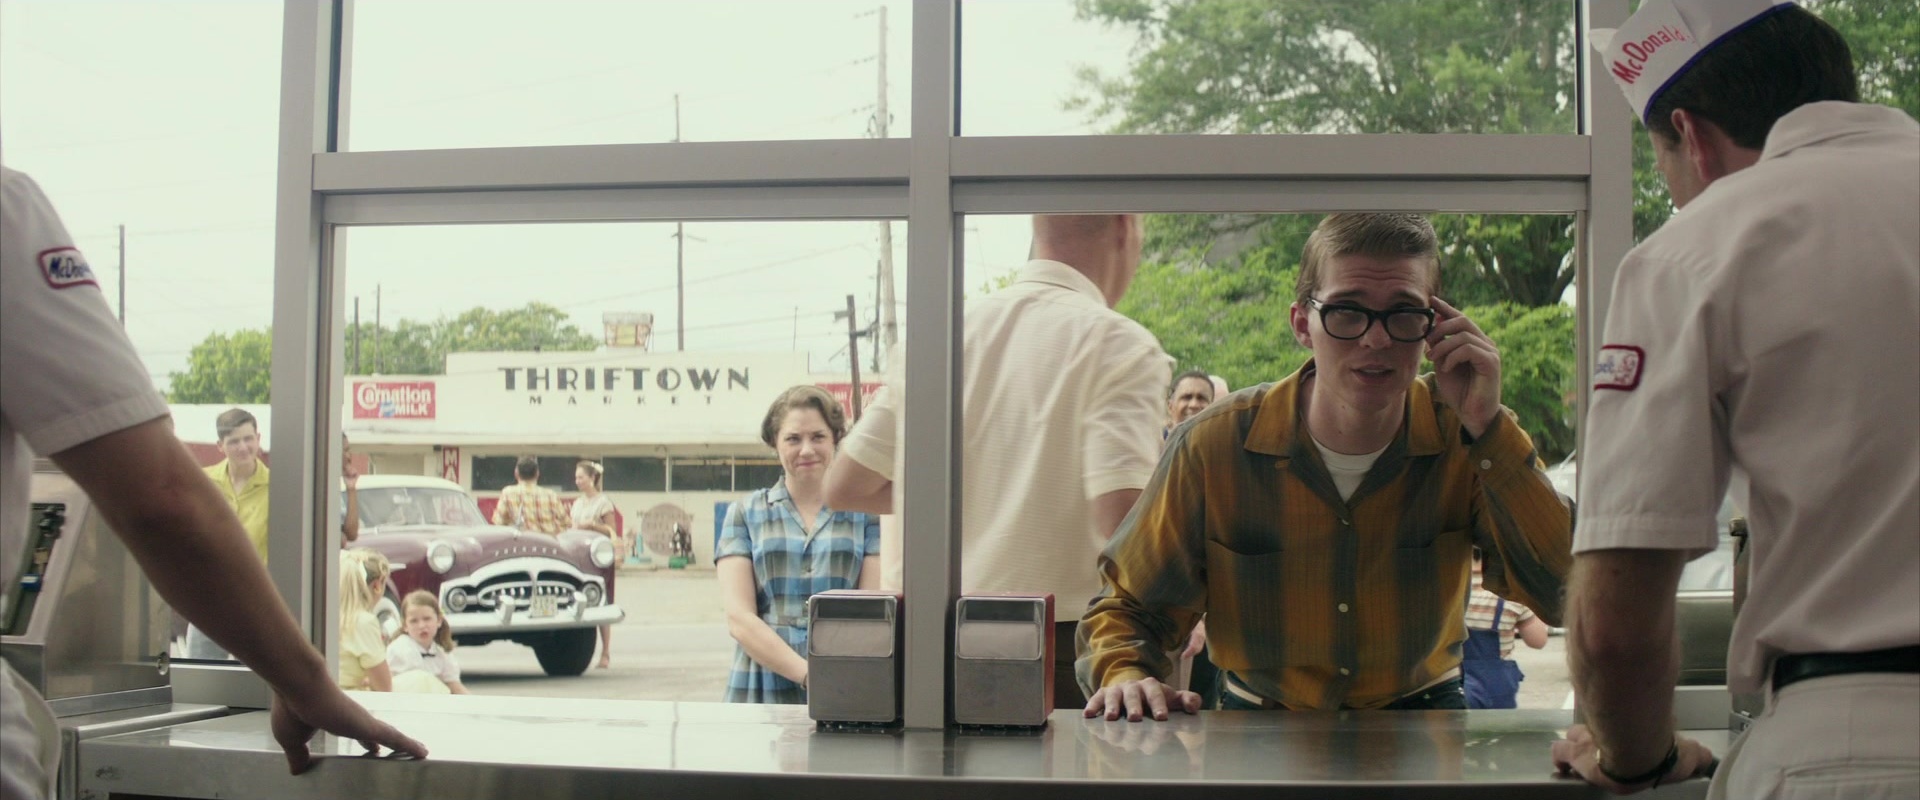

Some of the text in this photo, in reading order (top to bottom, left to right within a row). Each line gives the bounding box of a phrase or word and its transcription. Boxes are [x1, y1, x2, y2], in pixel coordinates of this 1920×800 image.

[498, 367, 749, 391] THRIFTOWN
[357, 383, 431, 410] Carnation
[529, 396, 712, 405] MARKET
[396, 403, 428, 415] MILK
